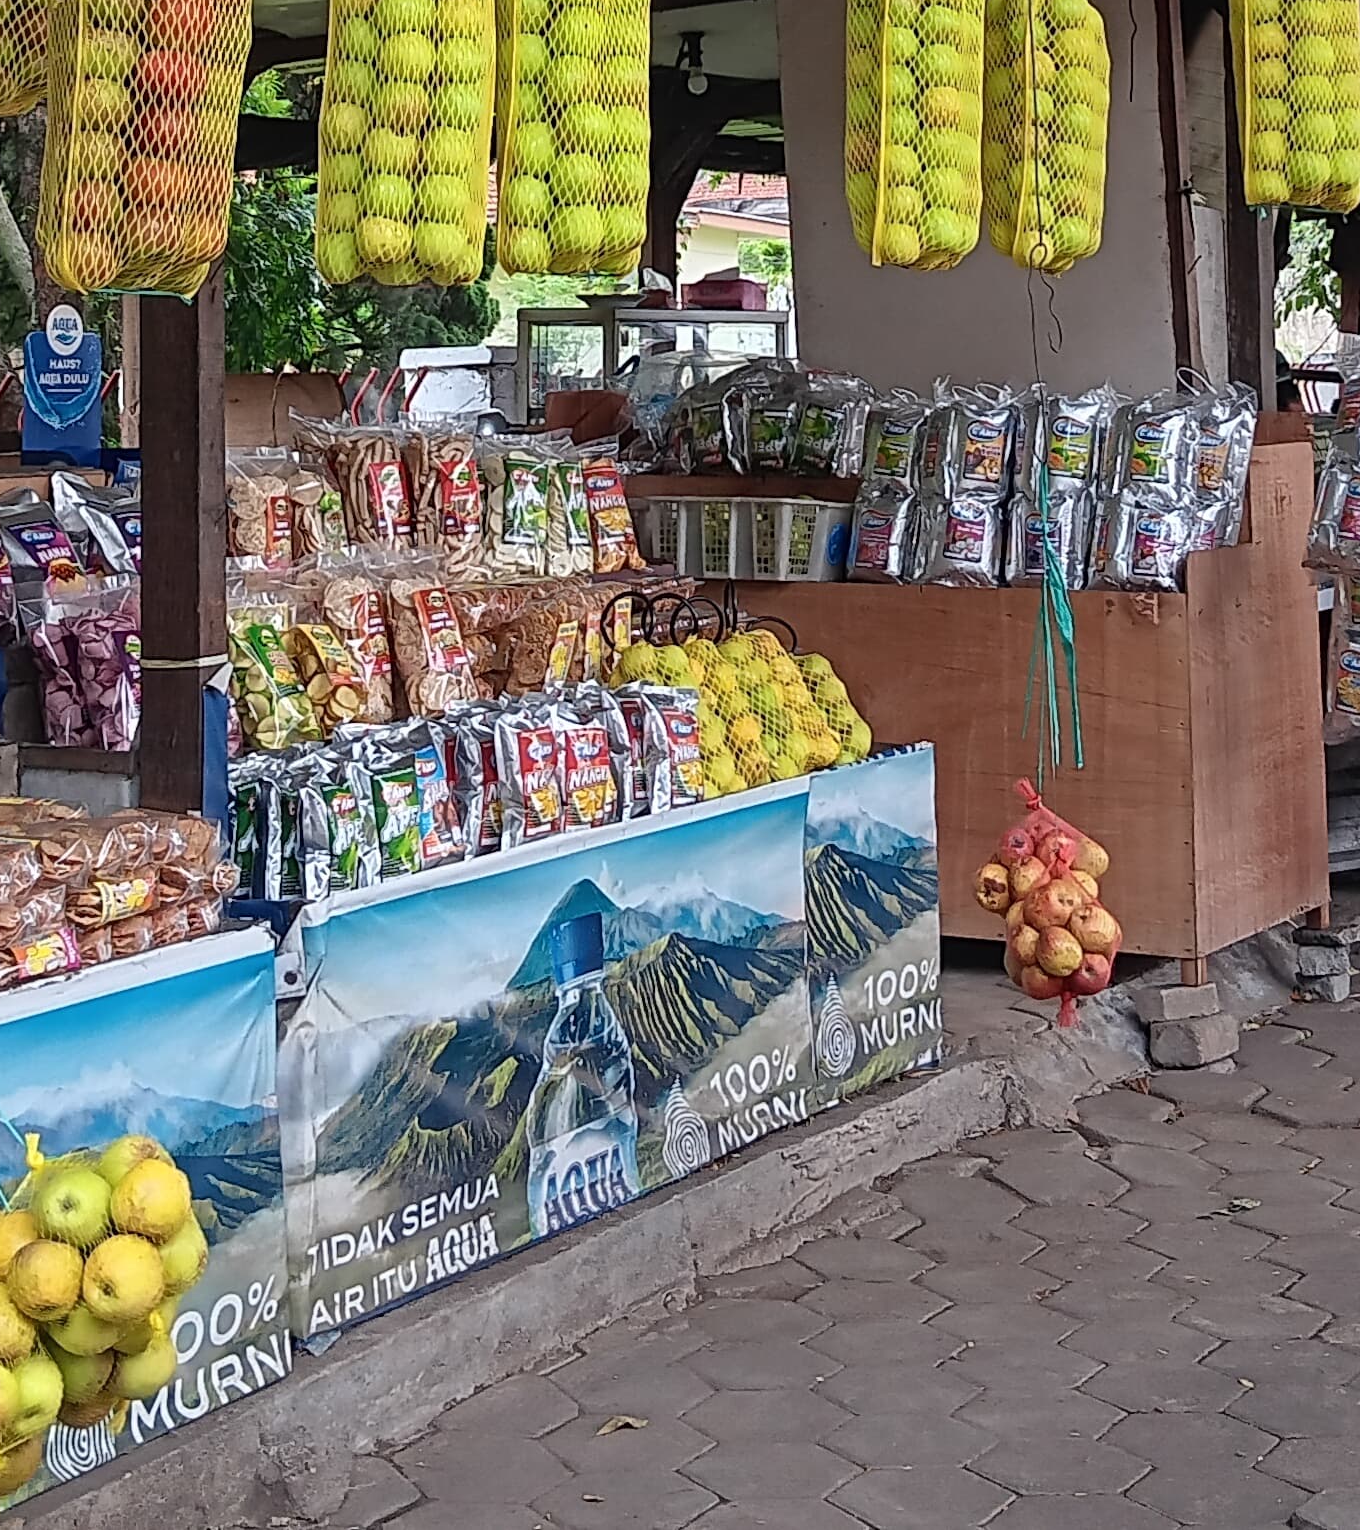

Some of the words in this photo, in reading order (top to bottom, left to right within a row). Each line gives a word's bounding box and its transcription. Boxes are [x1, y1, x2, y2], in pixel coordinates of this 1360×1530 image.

[52, 318, 78, 332] AQUA
[49, 359, 82, 370] HAUS?
[63, 372, 90, 385] DULU
[862, 957, 939, 1010] 100%
[859, 997, 942, 1055] MURNI
[709, 1044, 797, 1108] 100%
[716, 1087, 809, 1156] MURNI
[540, 1142, 637, 1239] AQUA
[306, 1211, 396, 1277] TIDAK
[401, 1173, 501, 1237] SEMUA
[309, 1286, 366, 1334] AIR
[372, 1259, 418, 1308] ITU
[425, 1213, 501, 1285] AQUA
[170, 1274, 279, 1365] 00%
[128, 1329, 293, 1446] MURNI
